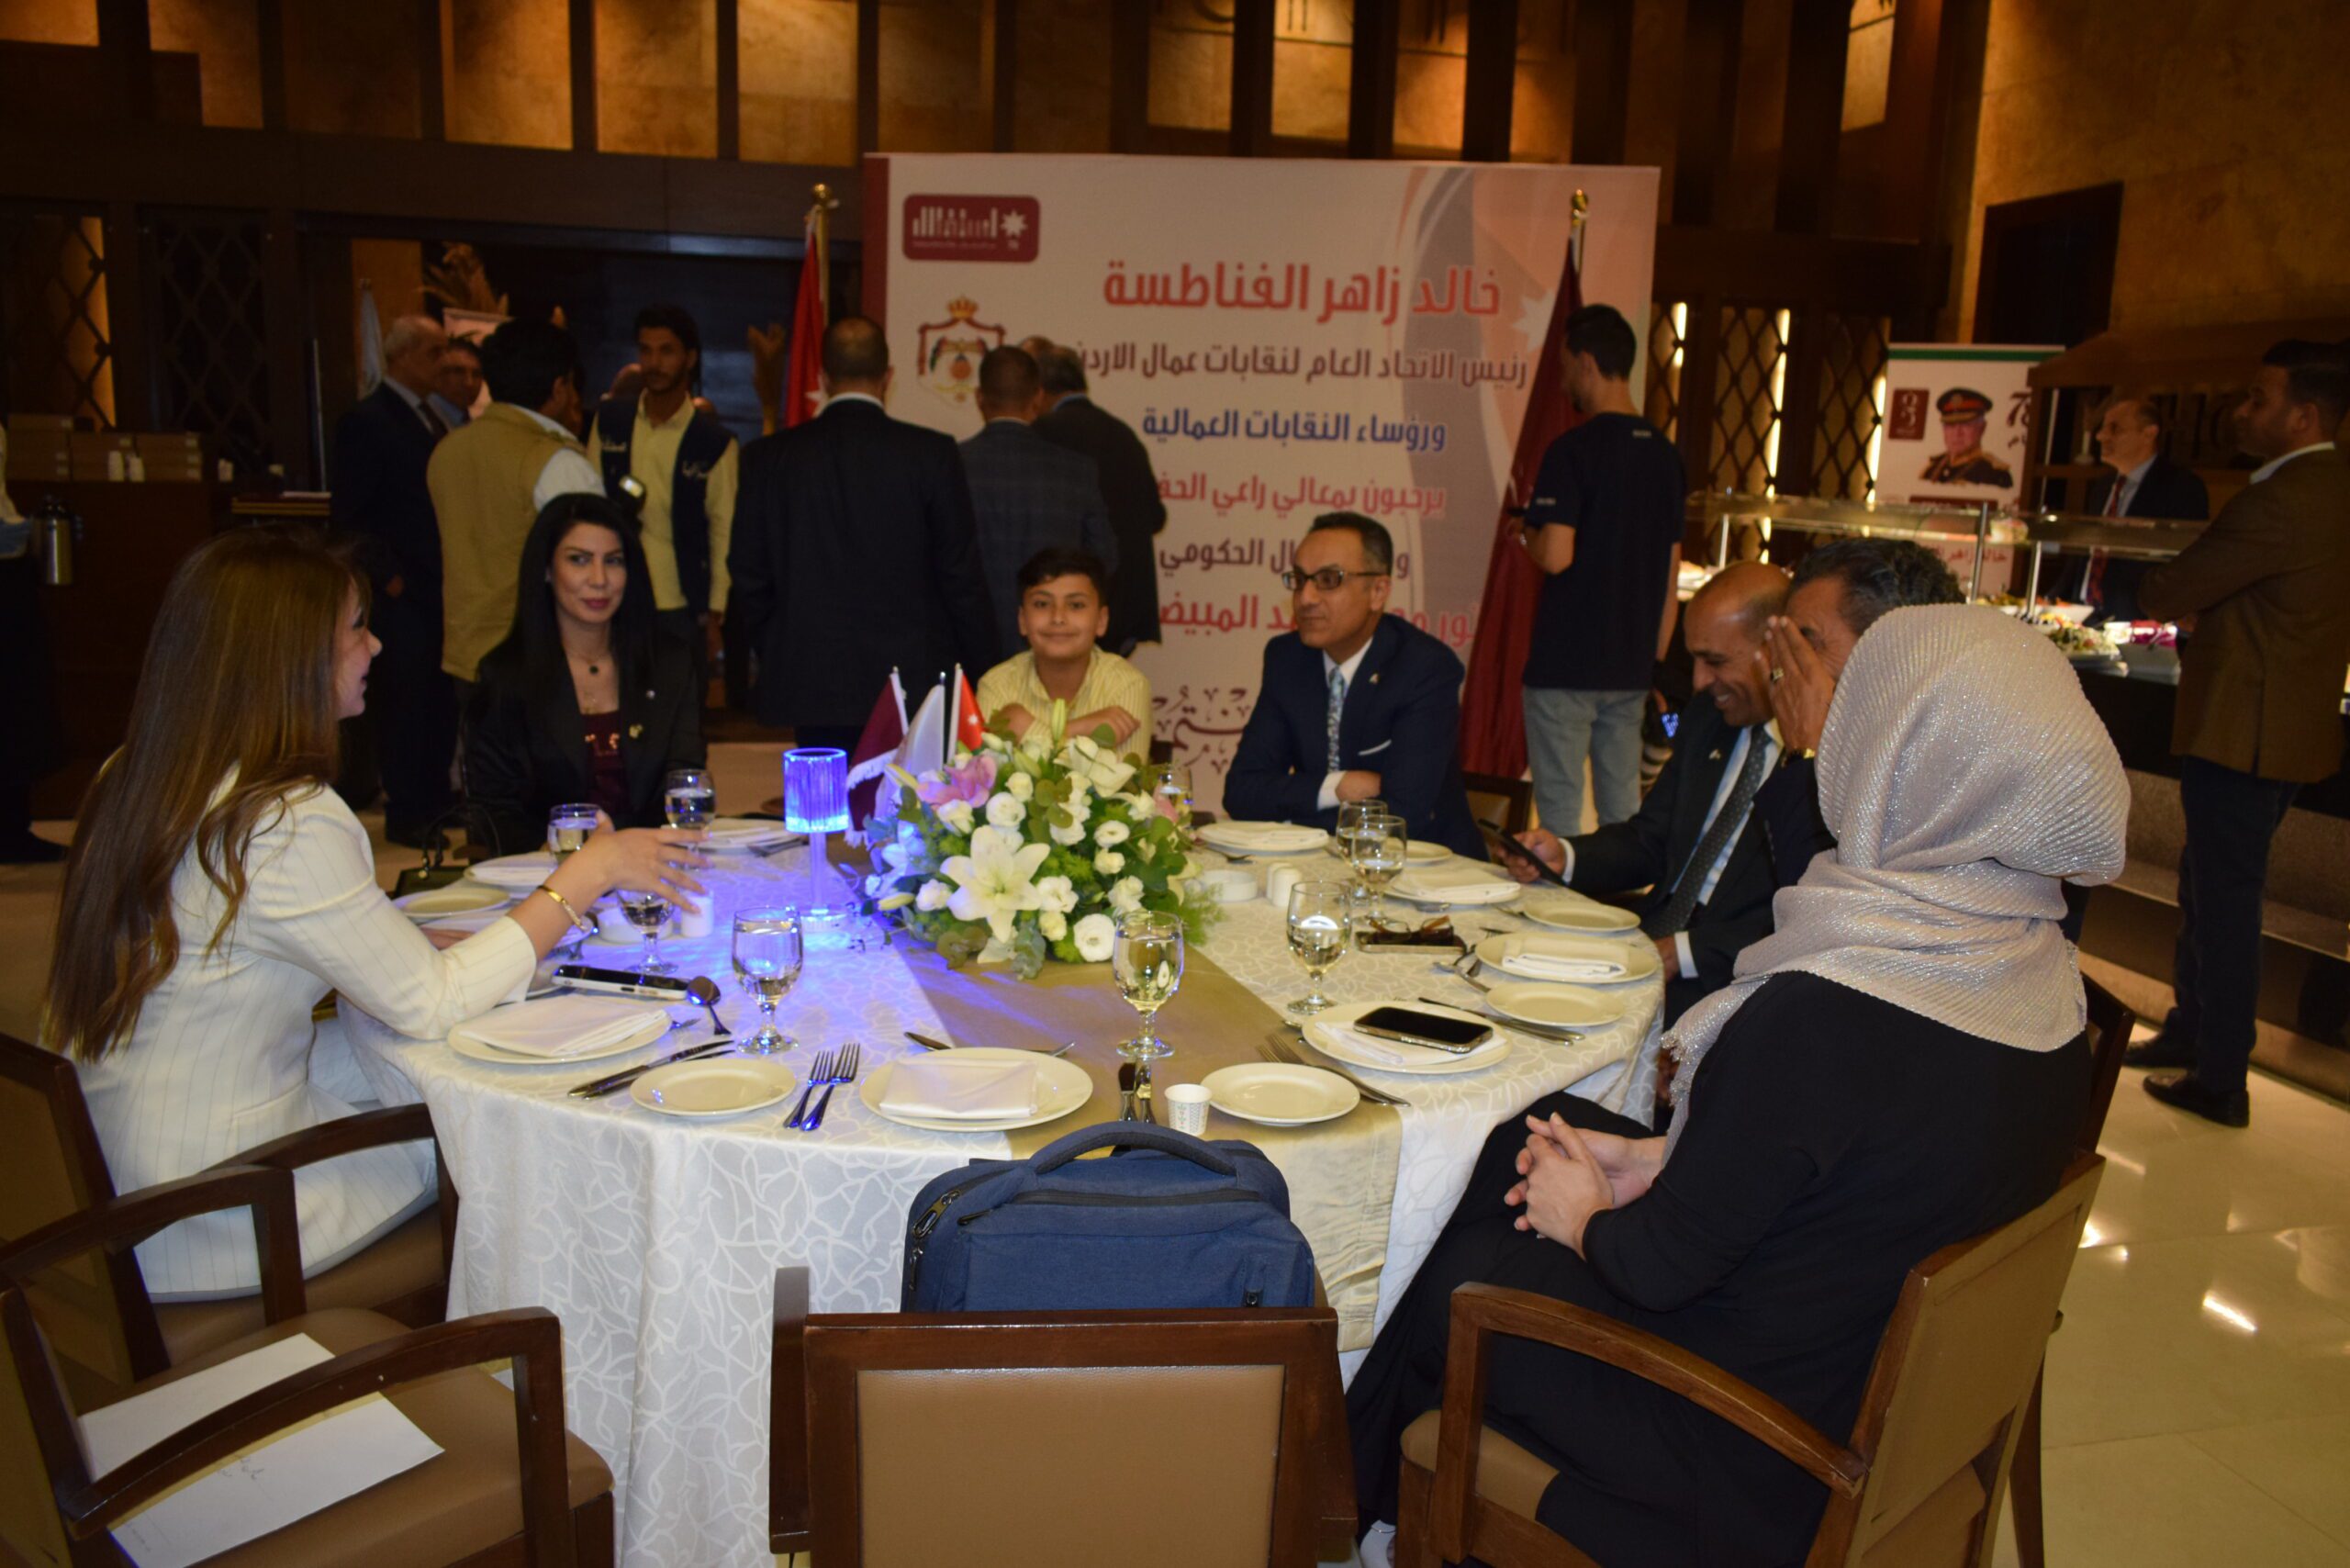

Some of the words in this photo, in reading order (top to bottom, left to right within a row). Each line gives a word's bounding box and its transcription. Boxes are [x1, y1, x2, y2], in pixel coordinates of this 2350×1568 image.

[1104, 261, 1310, 310] الفناطسة
[1316, 265, 1400, 326] زاهر
[1412, 267, 1500, 315] خالد
[1142, 342, 1198, 378] عمال
[1204, 344, 1300, 382] لنقابات
[1306, 348, 1371, 385] العام
[1378, 349, 1455, 379] الاتحاد
[1461, 353, 1527, 389] رئيس
[1143, 407, 1237, 443] العمالية
[1246, 410, 1349, 447] النقابات
[1356, 415, 1447, 452] ورؤساء
[1157, 471, 1206, 500] الحف
[1213, 474, 1266, 517] راعي
[1273, 476, 1356, 519] بمعالي
[1362, 479, 1445, 516] يرحبون
[1159, 538, 1264, 578] الحكومي
[1159, 590, 1259, 636] المبيض
